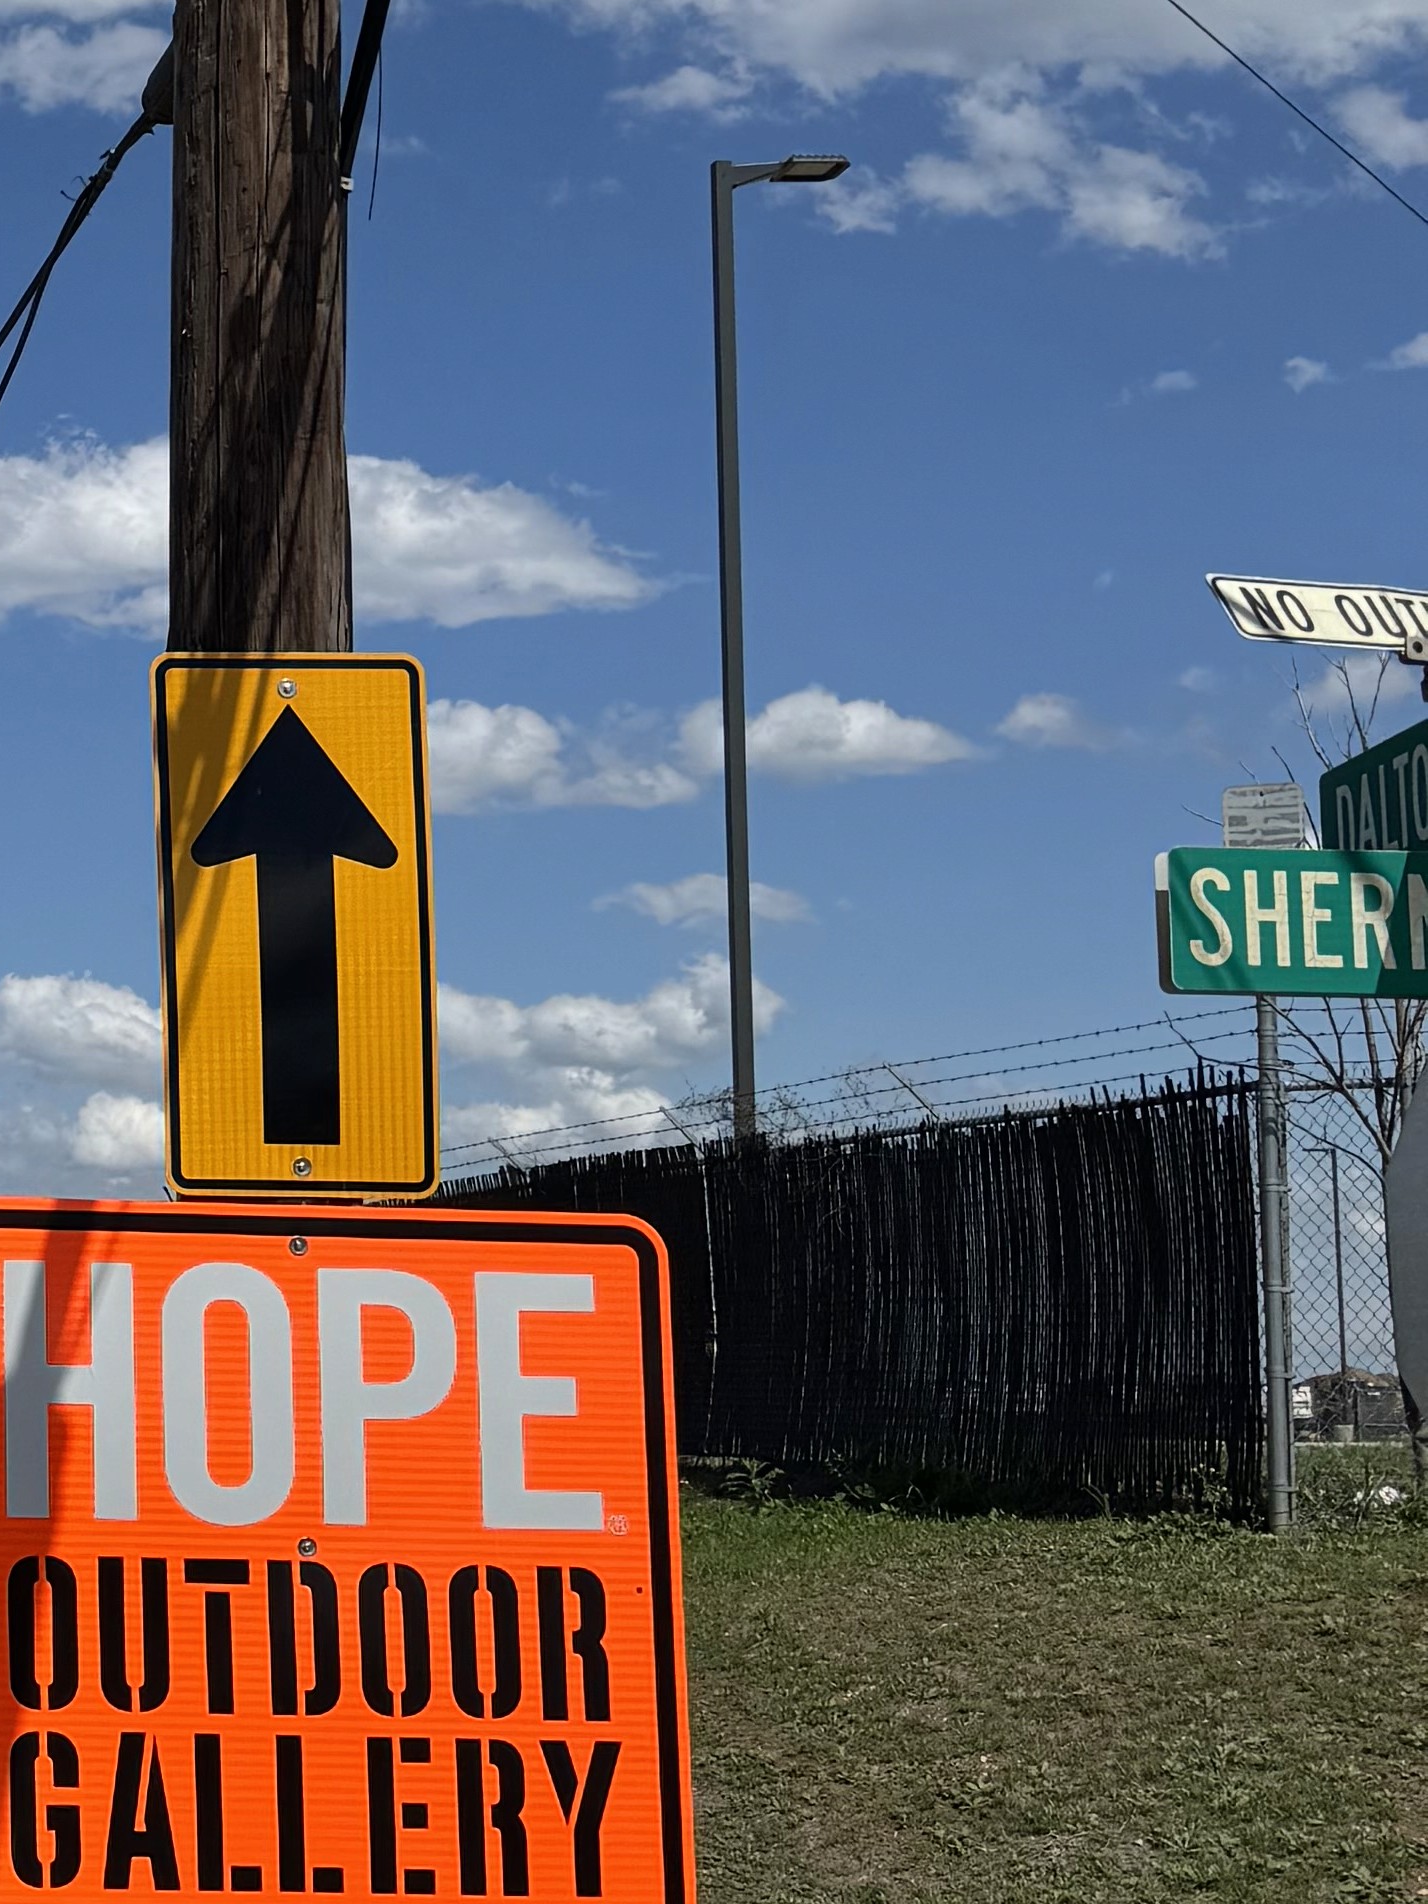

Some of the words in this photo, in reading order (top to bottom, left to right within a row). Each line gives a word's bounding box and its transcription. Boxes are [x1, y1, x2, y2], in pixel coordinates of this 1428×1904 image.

[1238, 586, 1315, 633] NO
[1334, 594, 1428, 639] OUT
[2, 1259, 604, 1532] HOPE
[7, 1554, 612, 1723] OUTDOOR
[9, 1730, 623, 1898] GALLERY
